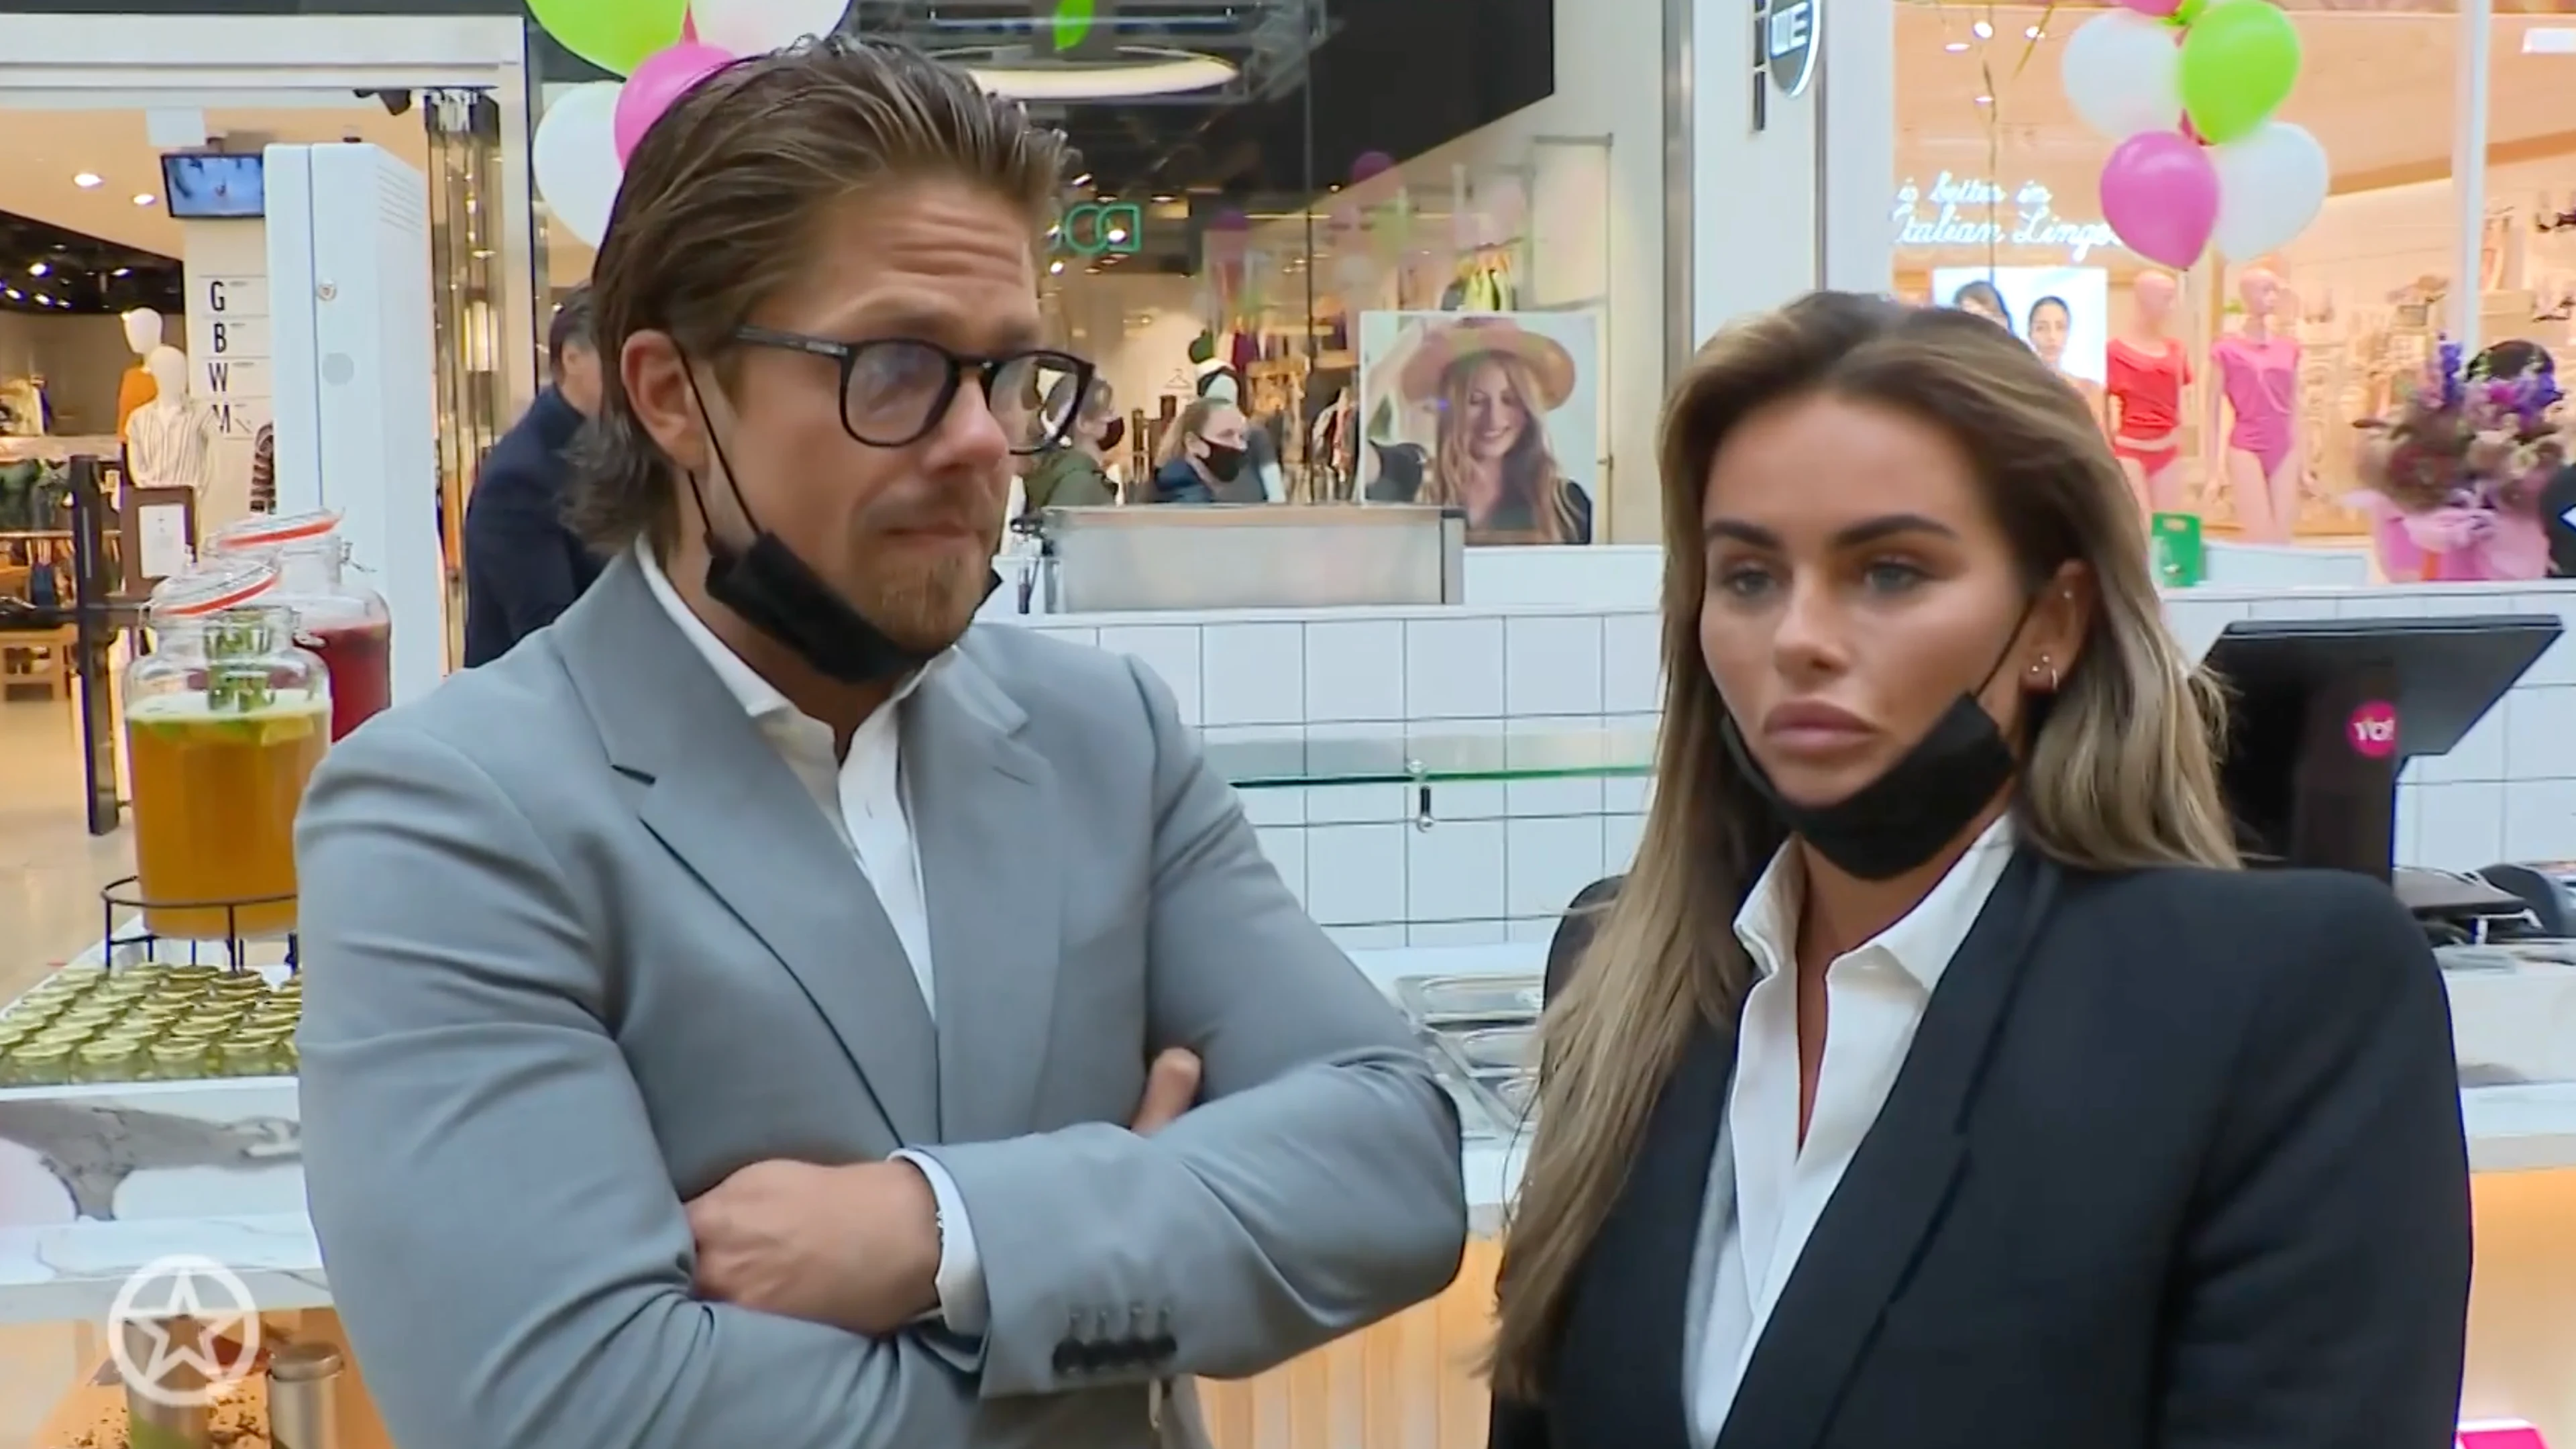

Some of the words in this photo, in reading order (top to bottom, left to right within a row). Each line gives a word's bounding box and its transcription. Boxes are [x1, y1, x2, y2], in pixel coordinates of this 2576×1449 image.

[1929, 170, 2007, 204] better
[2016, 179, 2053, 204] in
[1893, 203, 2006, 245] Italian
[210, 280, 226, 312] G
[213, 323, 227, 354] B
[208, 362, 229, 392] W
